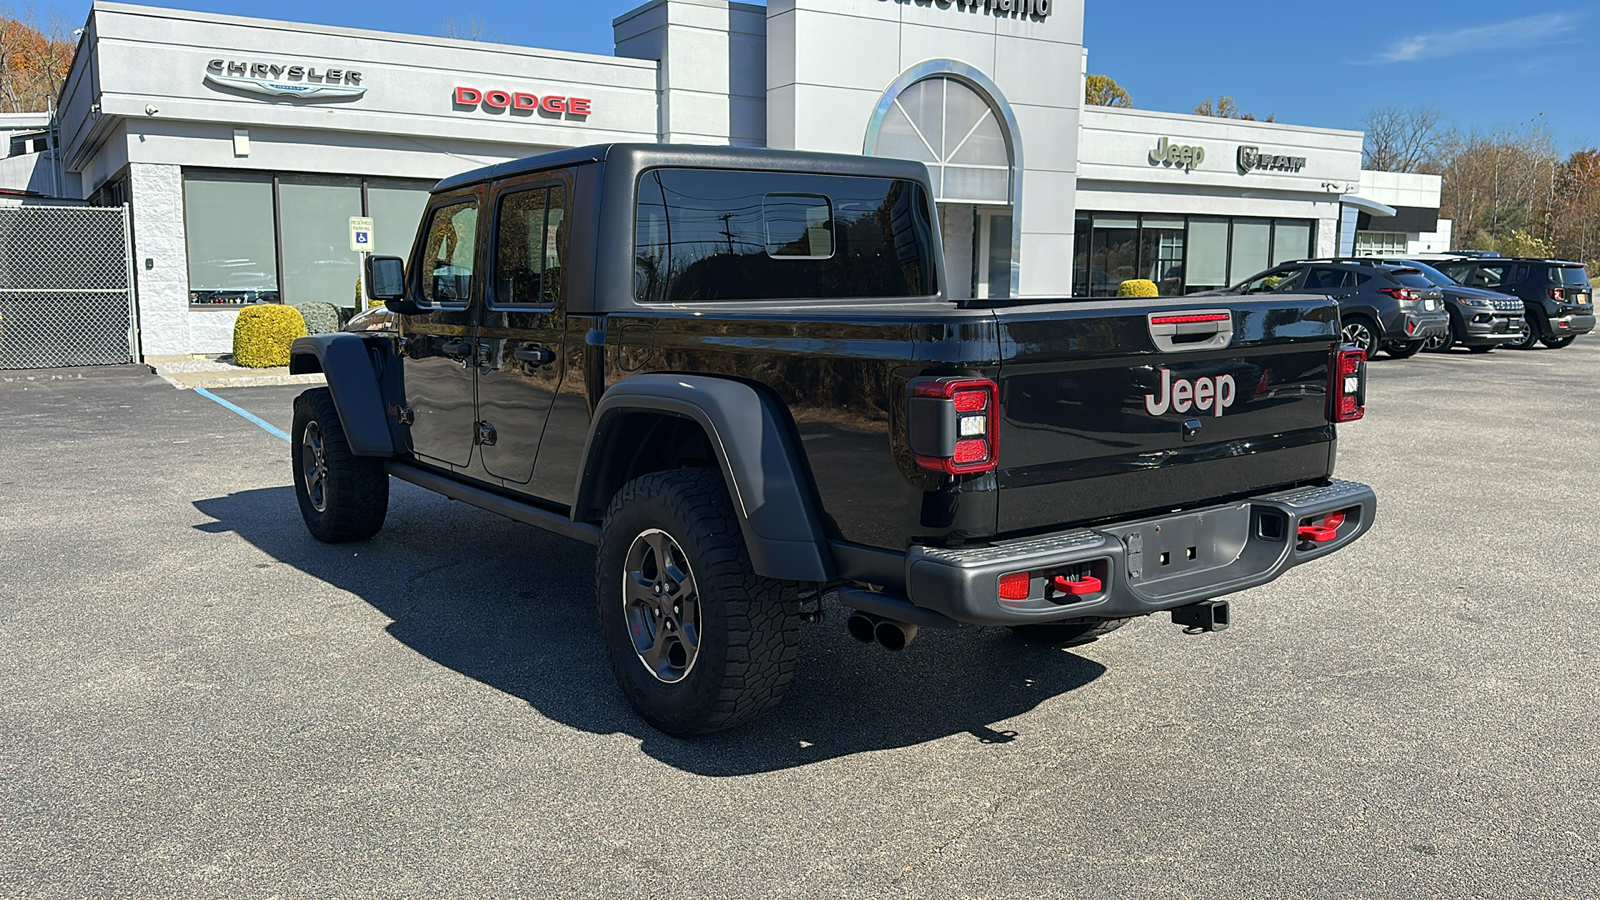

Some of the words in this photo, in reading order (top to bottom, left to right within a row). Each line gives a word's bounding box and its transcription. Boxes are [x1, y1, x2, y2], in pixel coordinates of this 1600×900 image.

[207, 59, 362, 84] CHRYSLER
[454, 87, 591, 116] DODGE
[1150, 137, 1205, 170] Jeep
[1260, 154, 1306, 169] RAM
[1144, 369, 1236, 418] Jeep
